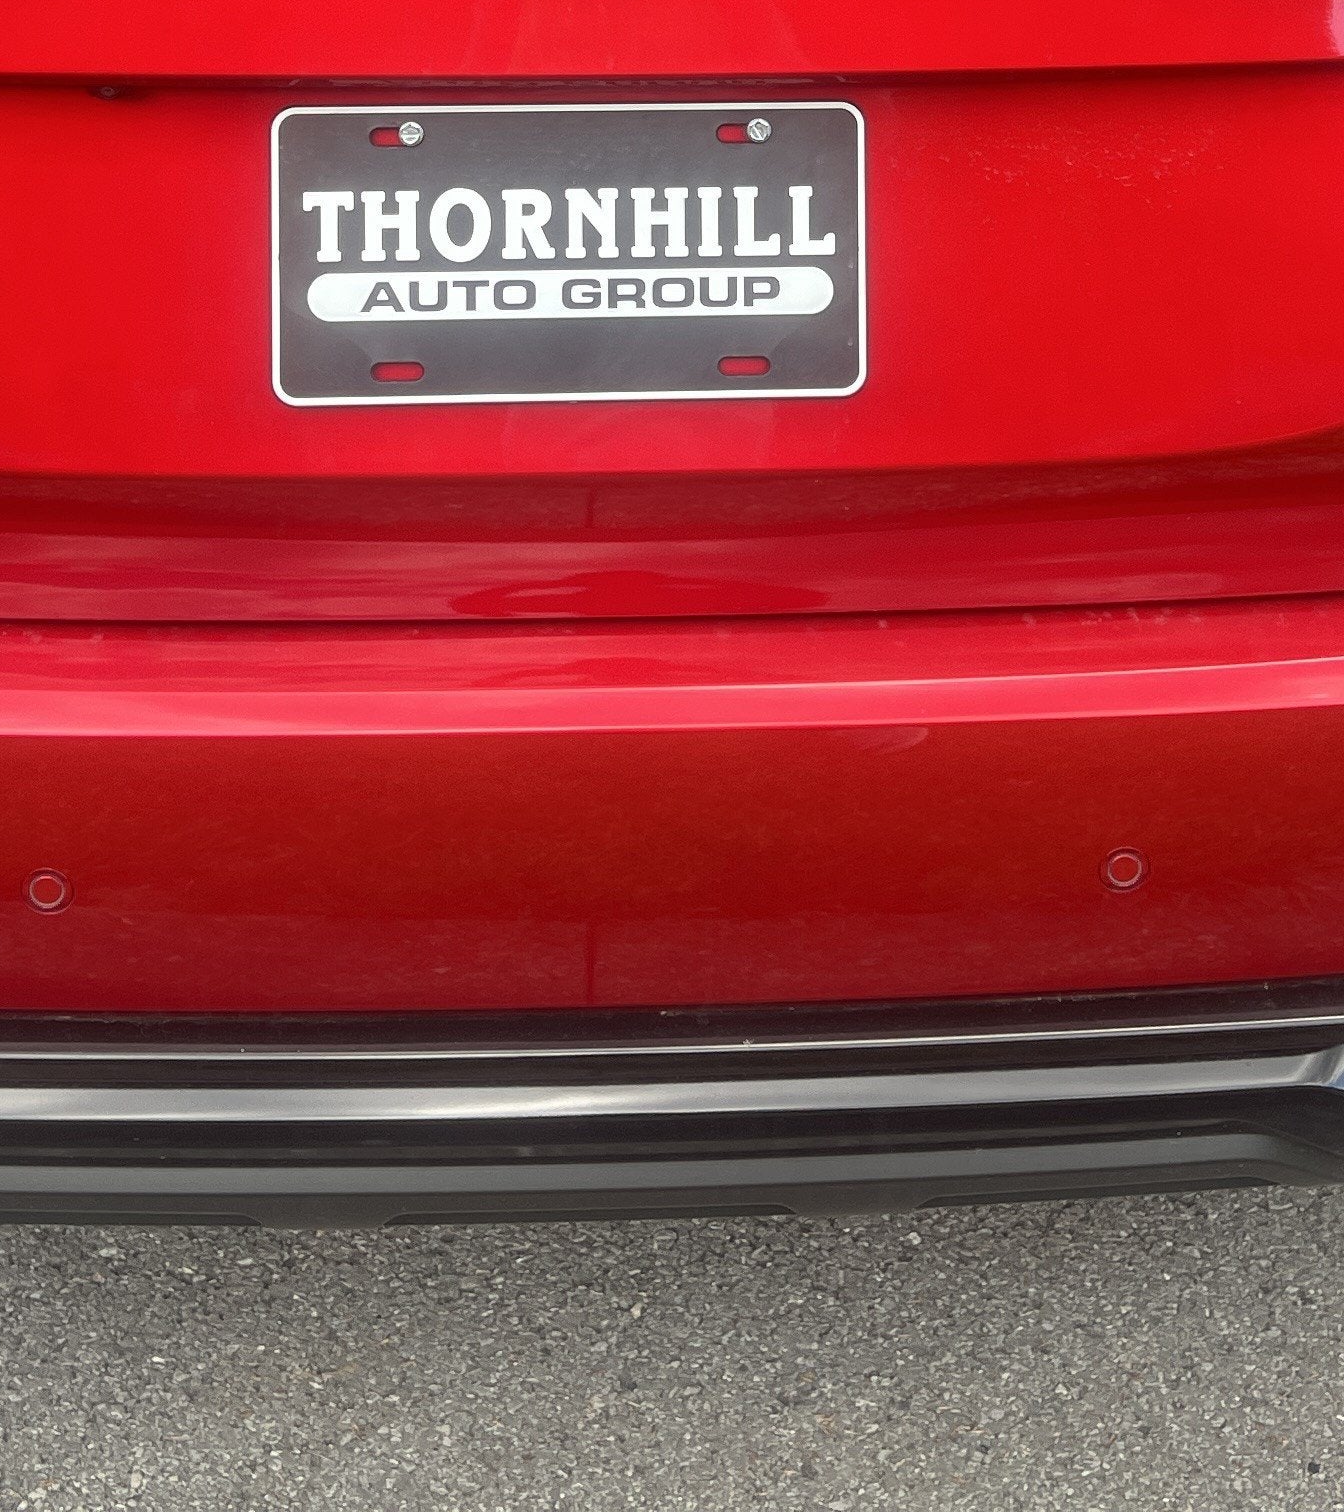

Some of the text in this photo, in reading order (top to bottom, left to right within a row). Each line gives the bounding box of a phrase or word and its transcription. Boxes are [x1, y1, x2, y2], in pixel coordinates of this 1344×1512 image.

[302, 185, 836, 263] THORNHILL
[360, 275, 781, 314] AUTO GROUP
